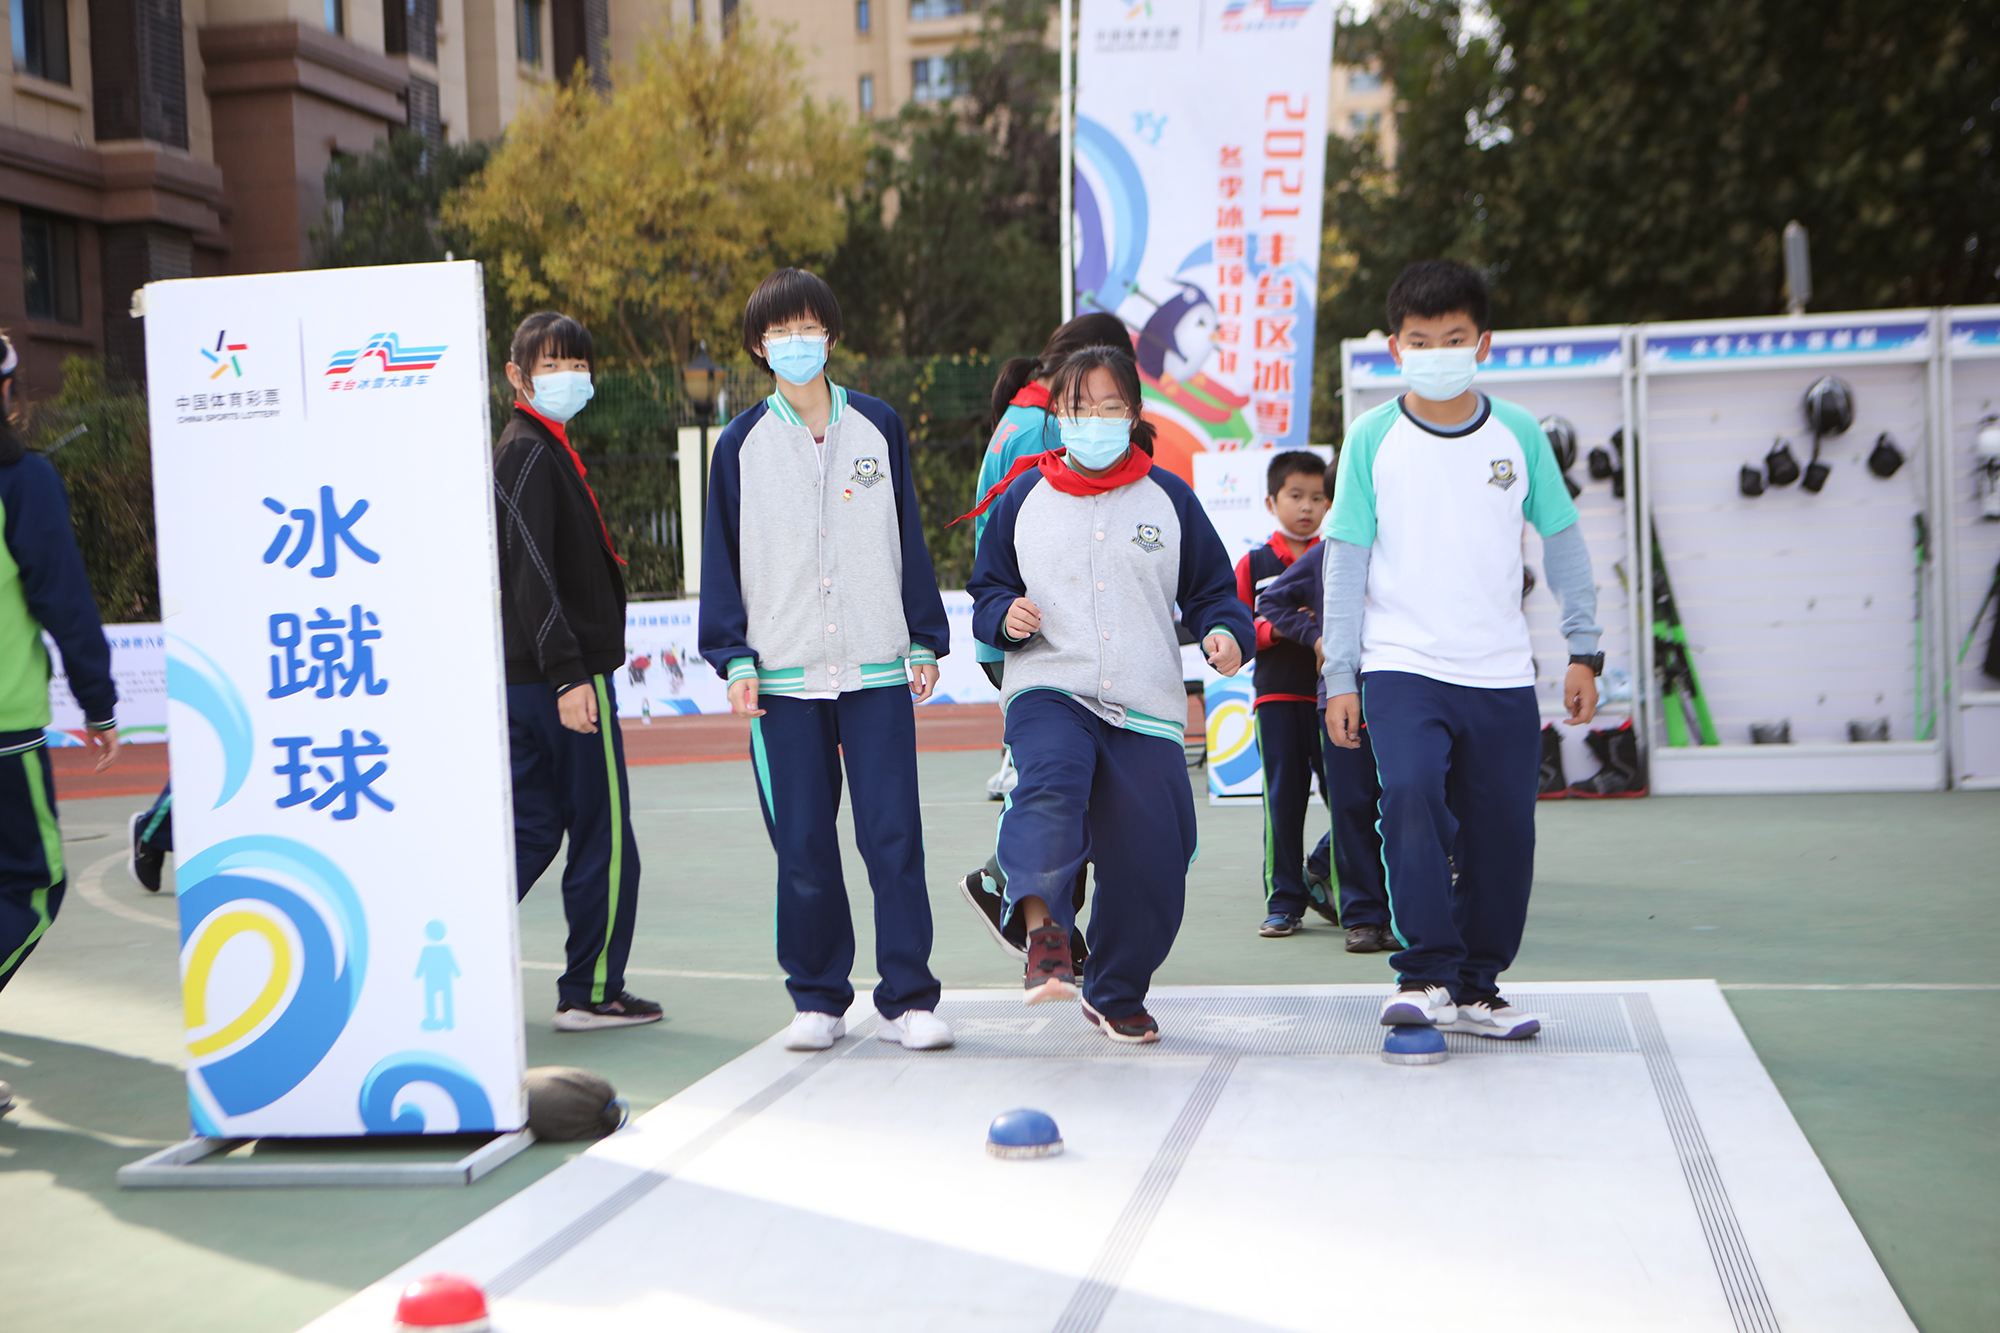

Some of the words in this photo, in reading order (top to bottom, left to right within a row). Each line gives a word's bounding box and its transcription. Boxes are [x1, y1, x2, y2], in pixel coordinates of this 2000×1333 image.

[175, 388, 280, 411] 中国体育彩票
[262, 484, 395, 821] 冰蹴球
